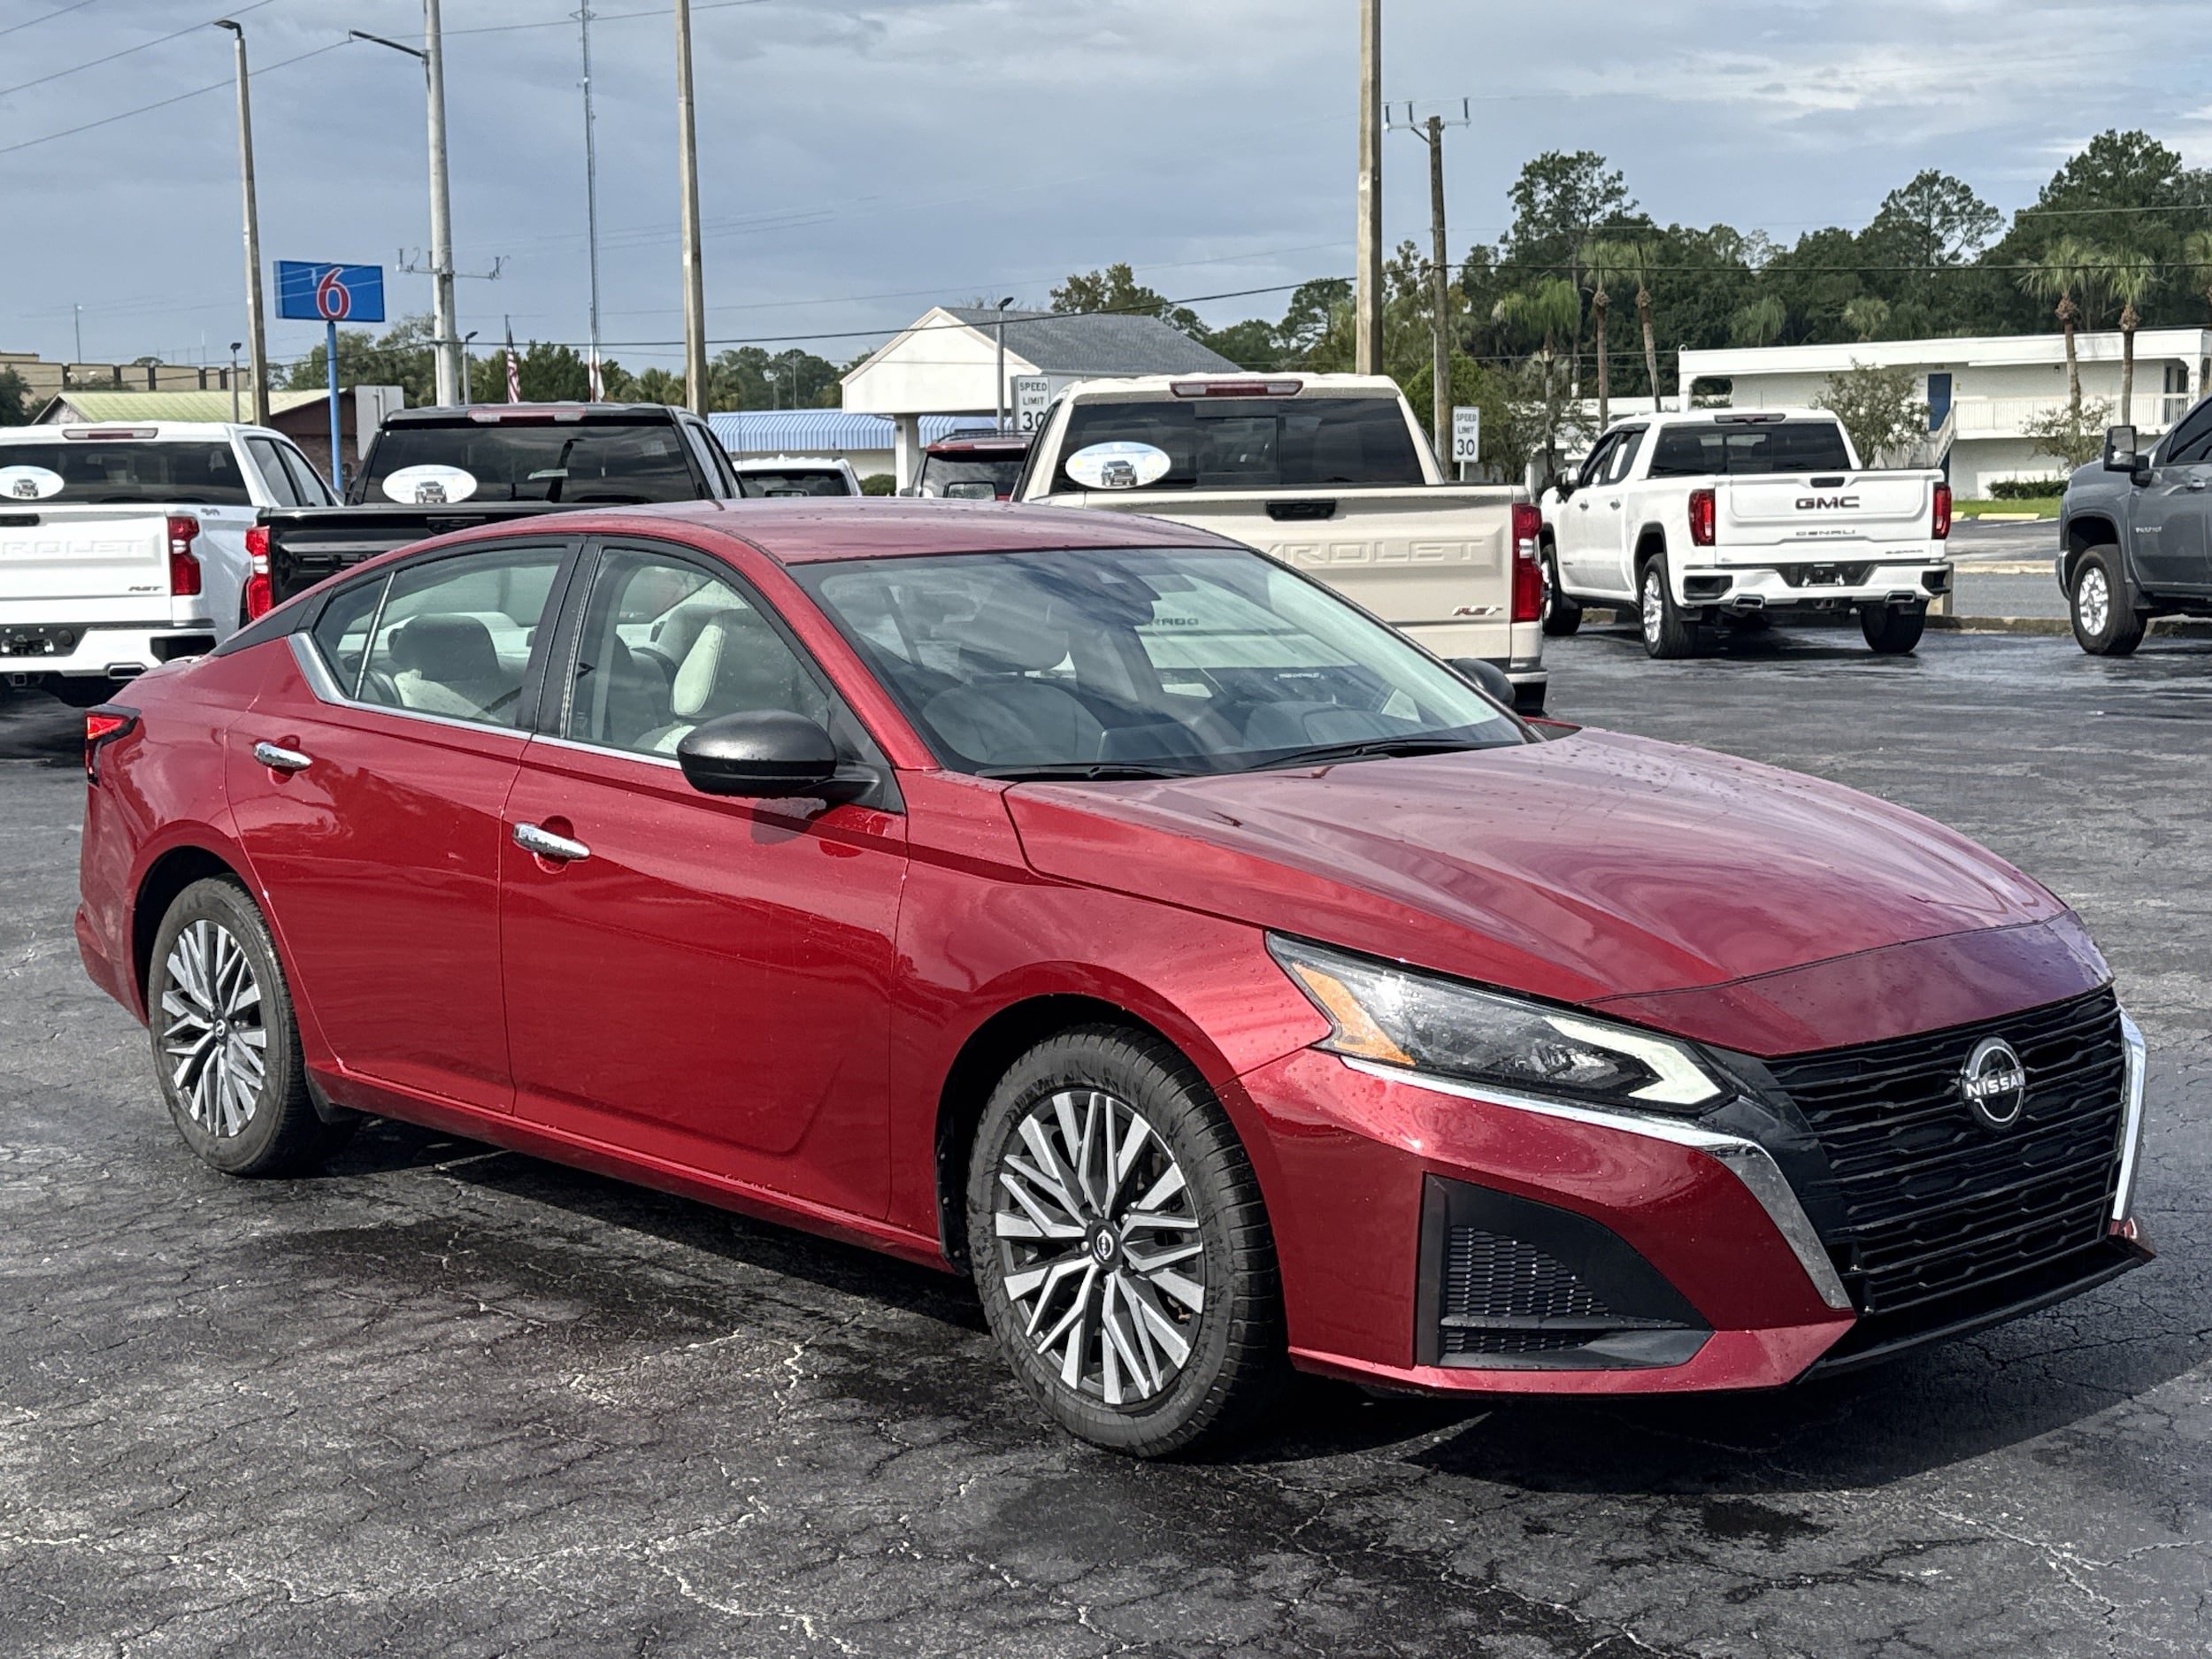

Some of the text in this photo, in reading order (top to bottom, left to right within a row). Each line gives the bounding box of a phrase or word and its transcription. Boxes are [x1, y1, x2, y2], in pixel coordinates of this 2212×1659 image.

[317, 267, 351, 319] 6
[1019, 382, 1048, 391] SPEED
[1023, 396, 1045, 405] LIMIT
[1022, 411, 1045, 430] 30
[1455, 413, 1477, 422] SPEED
[1456, 439, 1475, 456] 30
[1795, 496, 1860, 510] GMC
[1966, 1071, 2024, 1097] NISSAN
